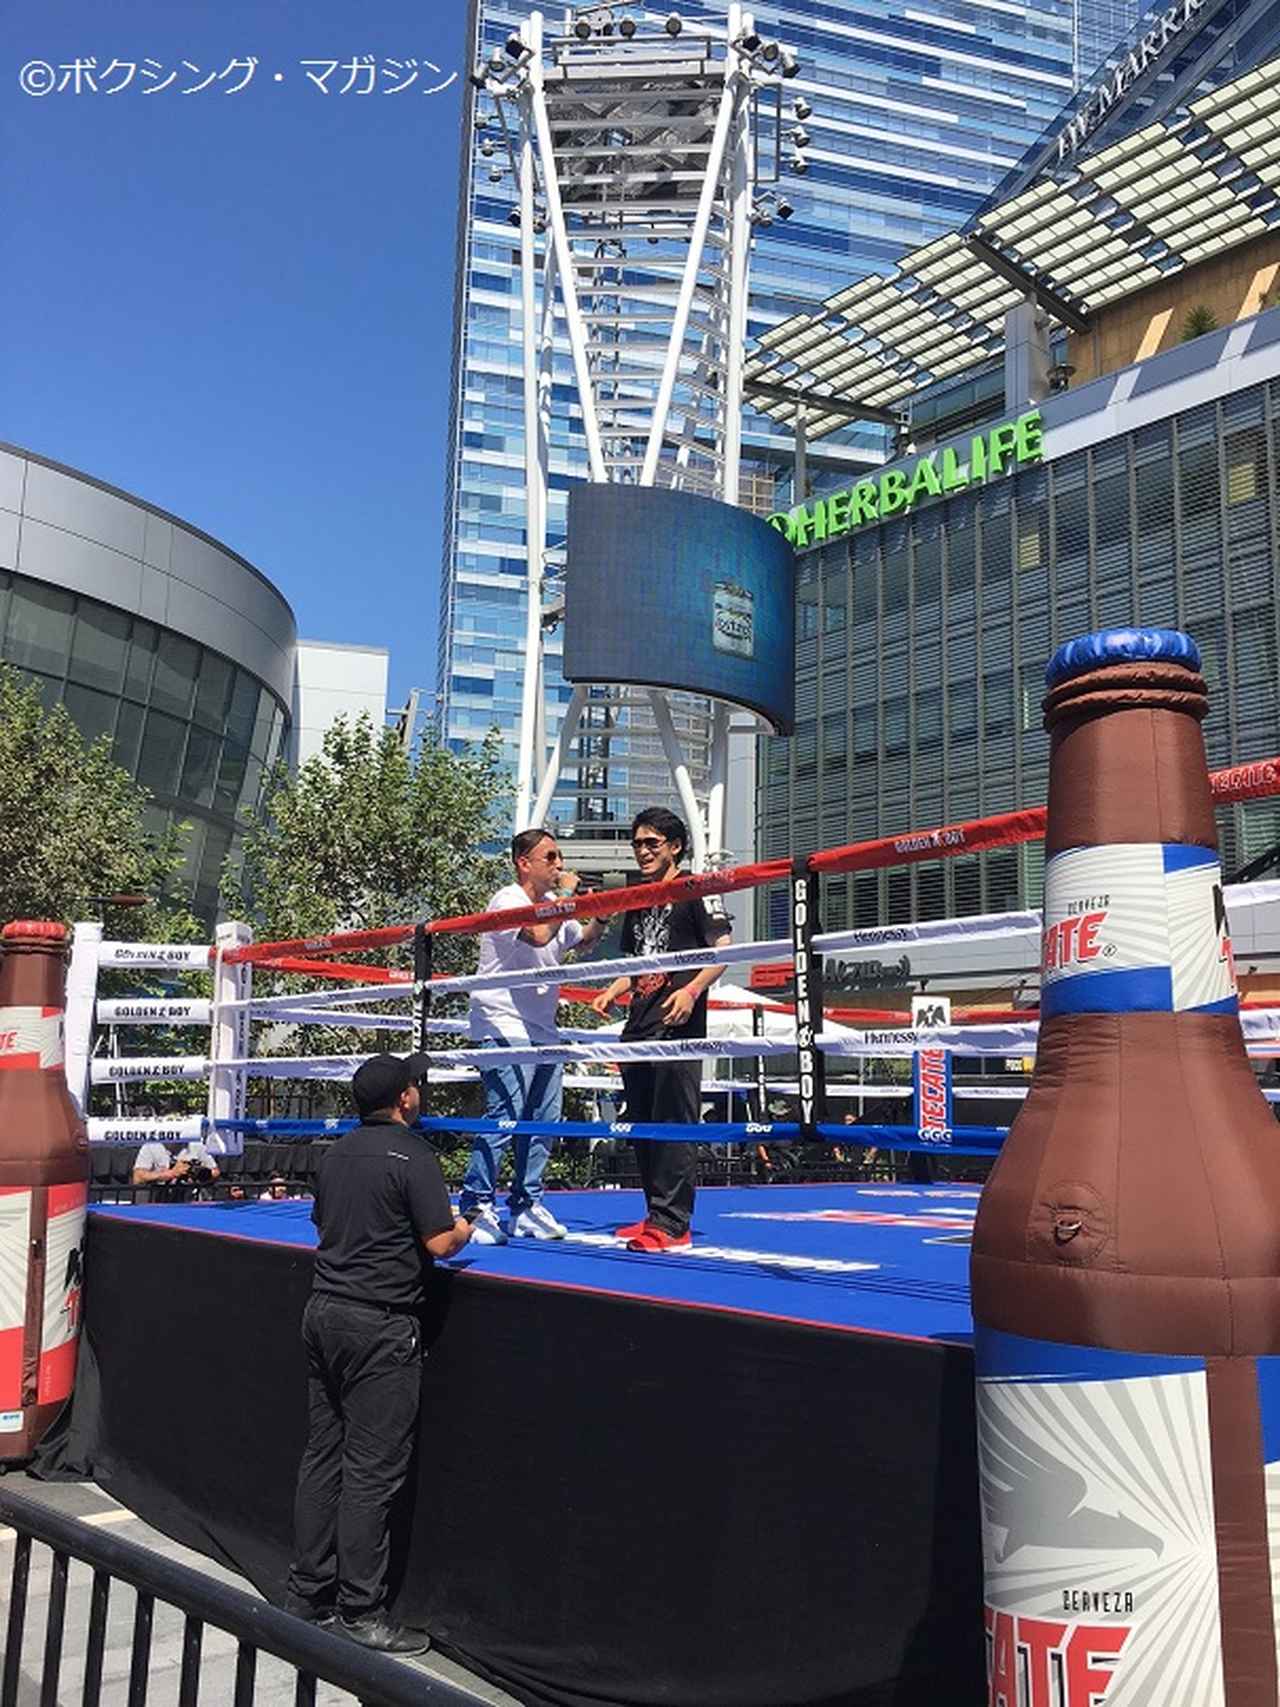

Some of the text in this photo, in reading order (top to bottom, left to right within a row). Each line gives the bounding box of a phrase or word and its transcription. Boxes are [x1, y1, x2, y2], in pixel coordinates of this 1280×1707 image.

[795, 409, 1043, 547] HERBALIFE
[114, 1006, 157, 1017] GOLDEN
[794, 879, 814, 1125] GOLDEN BOY
[864, 1030, 918, 1046] Hennessy
[104, 1130, 147, 1141] GOLDEN
[1062, 1589, 1134, 1613] CERVEZA
